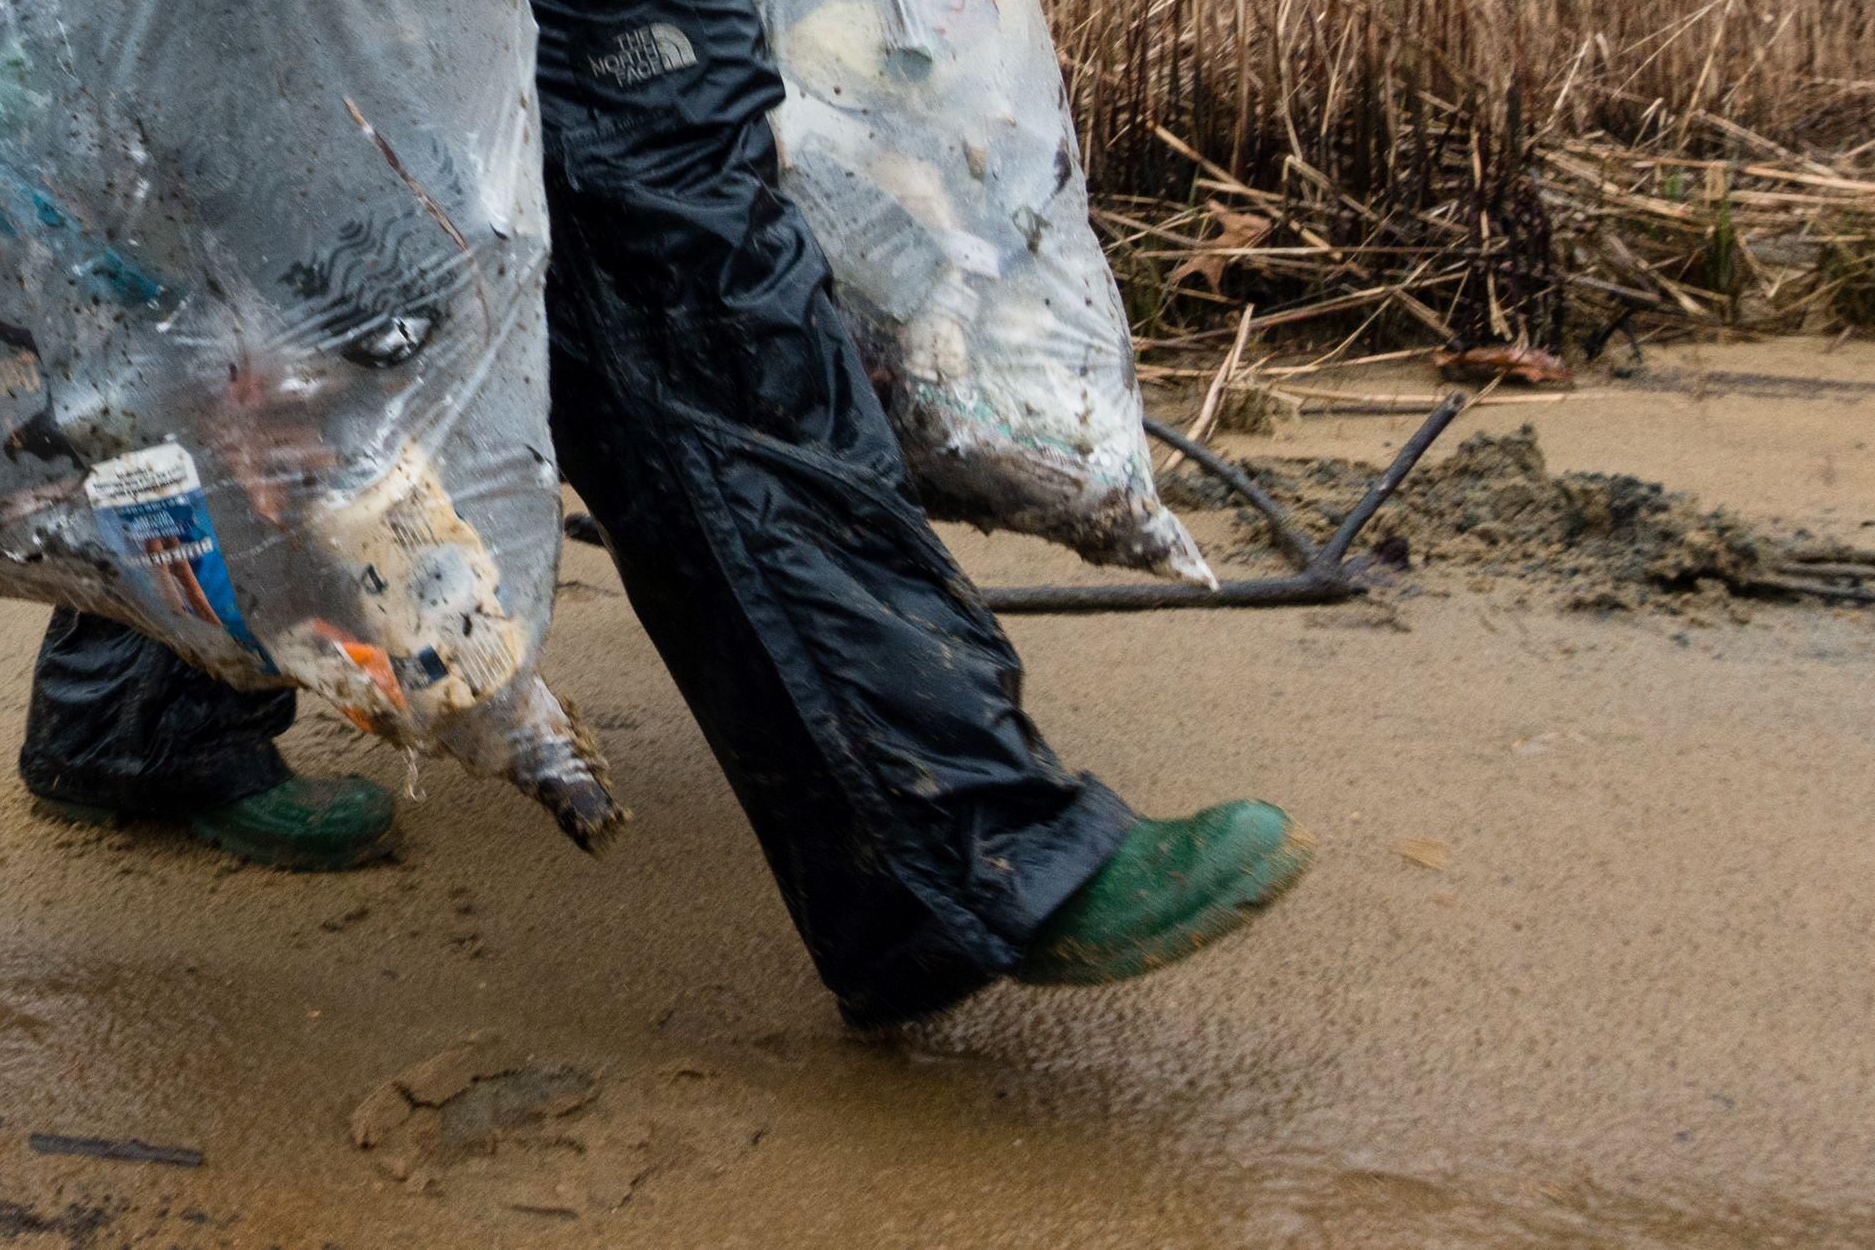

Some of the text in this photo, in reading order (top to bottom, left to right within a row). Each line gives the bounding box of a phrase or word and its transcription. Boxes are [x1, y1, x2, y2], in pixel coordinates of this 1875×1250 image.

[613, 26, 652, 52] THE
[587, 44, 659, 78] NORTH
[615, 58, 664, 88] FACE
